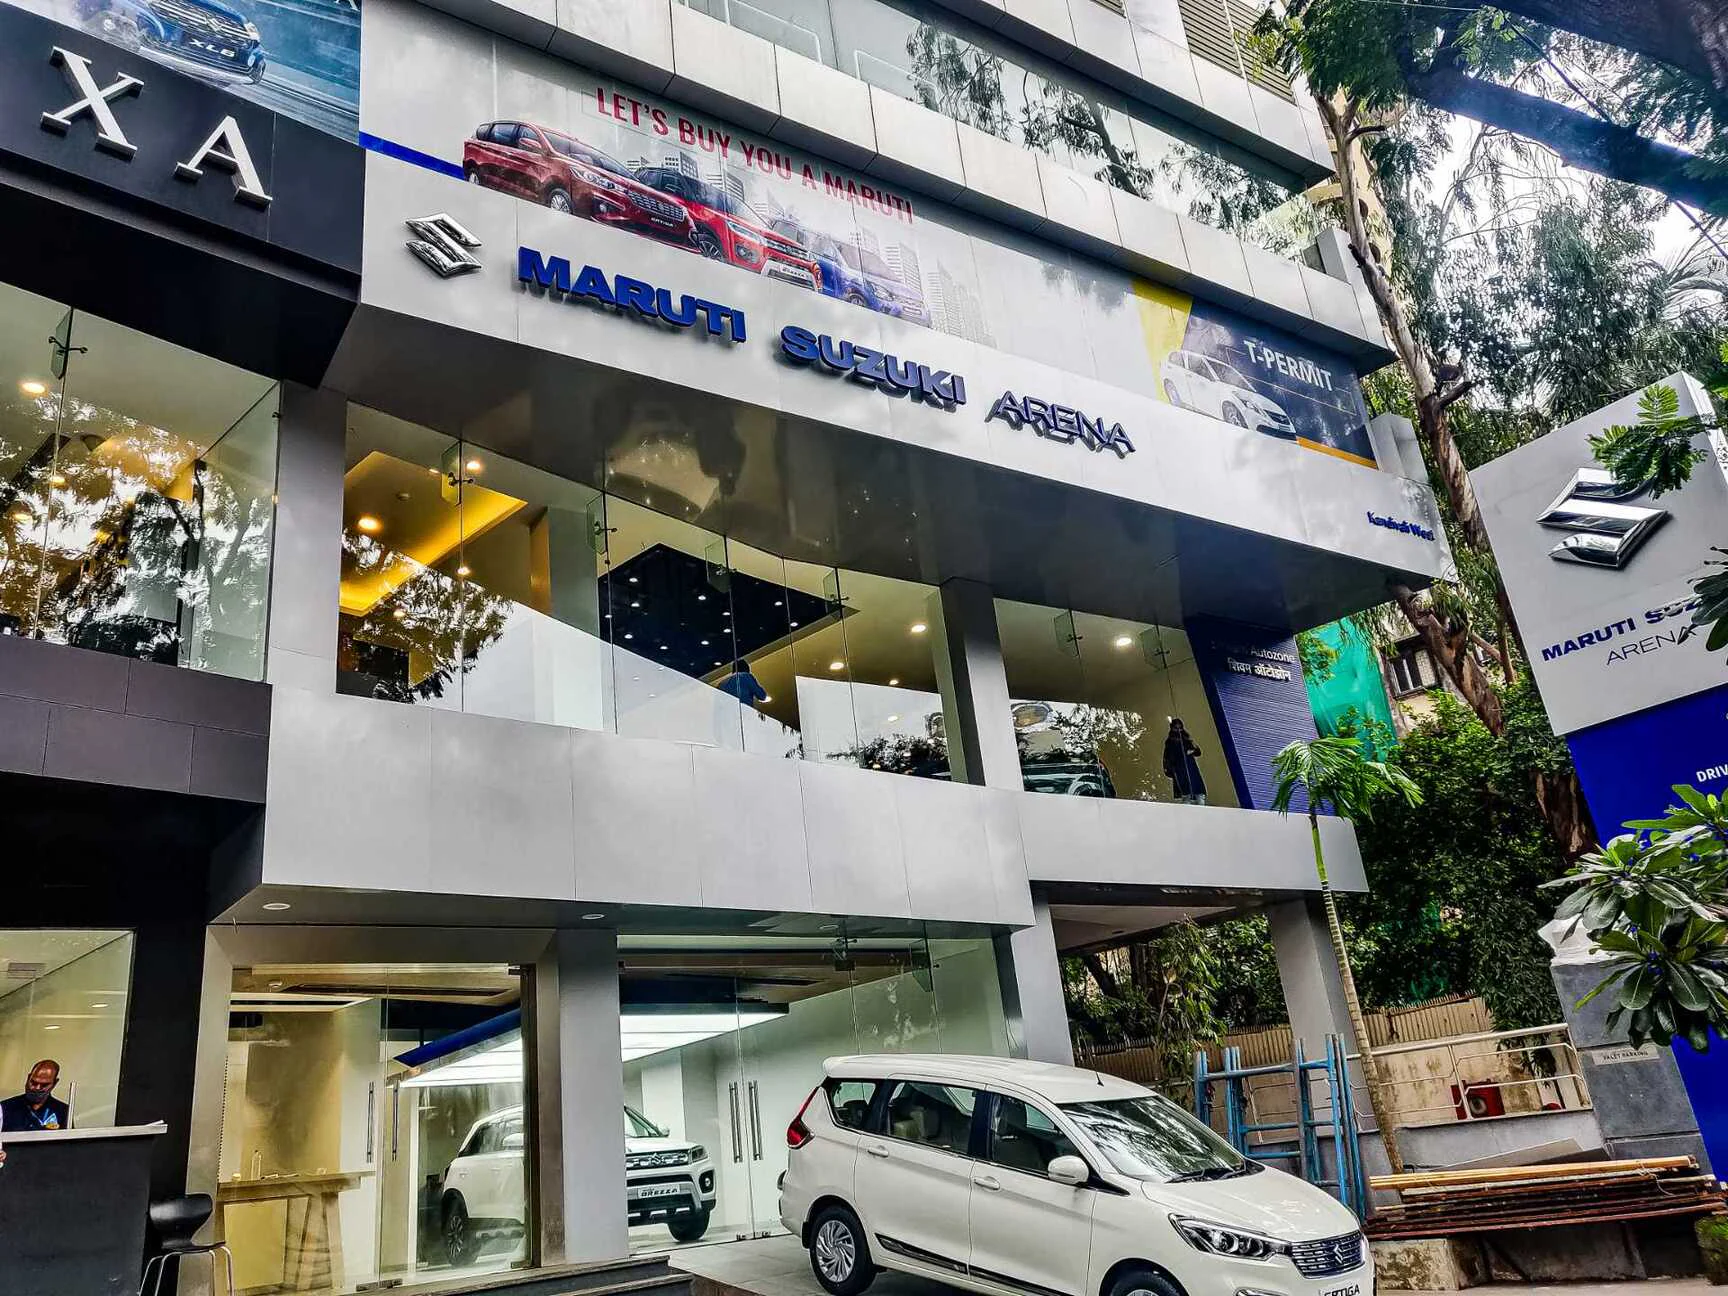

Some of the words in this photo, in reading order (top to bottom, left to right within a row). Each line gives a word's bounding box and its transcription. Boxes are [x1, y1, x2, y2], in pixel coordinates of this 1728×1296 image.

[596, 87, 669, 136] LET'S
[678, 117, 731, 159] BUY
[739, 140, 792, 181] YOU
[802, 163, 817, 190] A
[824, 171, 914, 225] MARUTI
[517, 245, 747, 343] MARUTI
[780, 324, 967, 406] SUZUKI
[986, 391, 1137, 456] ARENA
[1243, 338, 1334, 392] T-PERMIT
[1541, 617, 1637, 662] MARUTI
